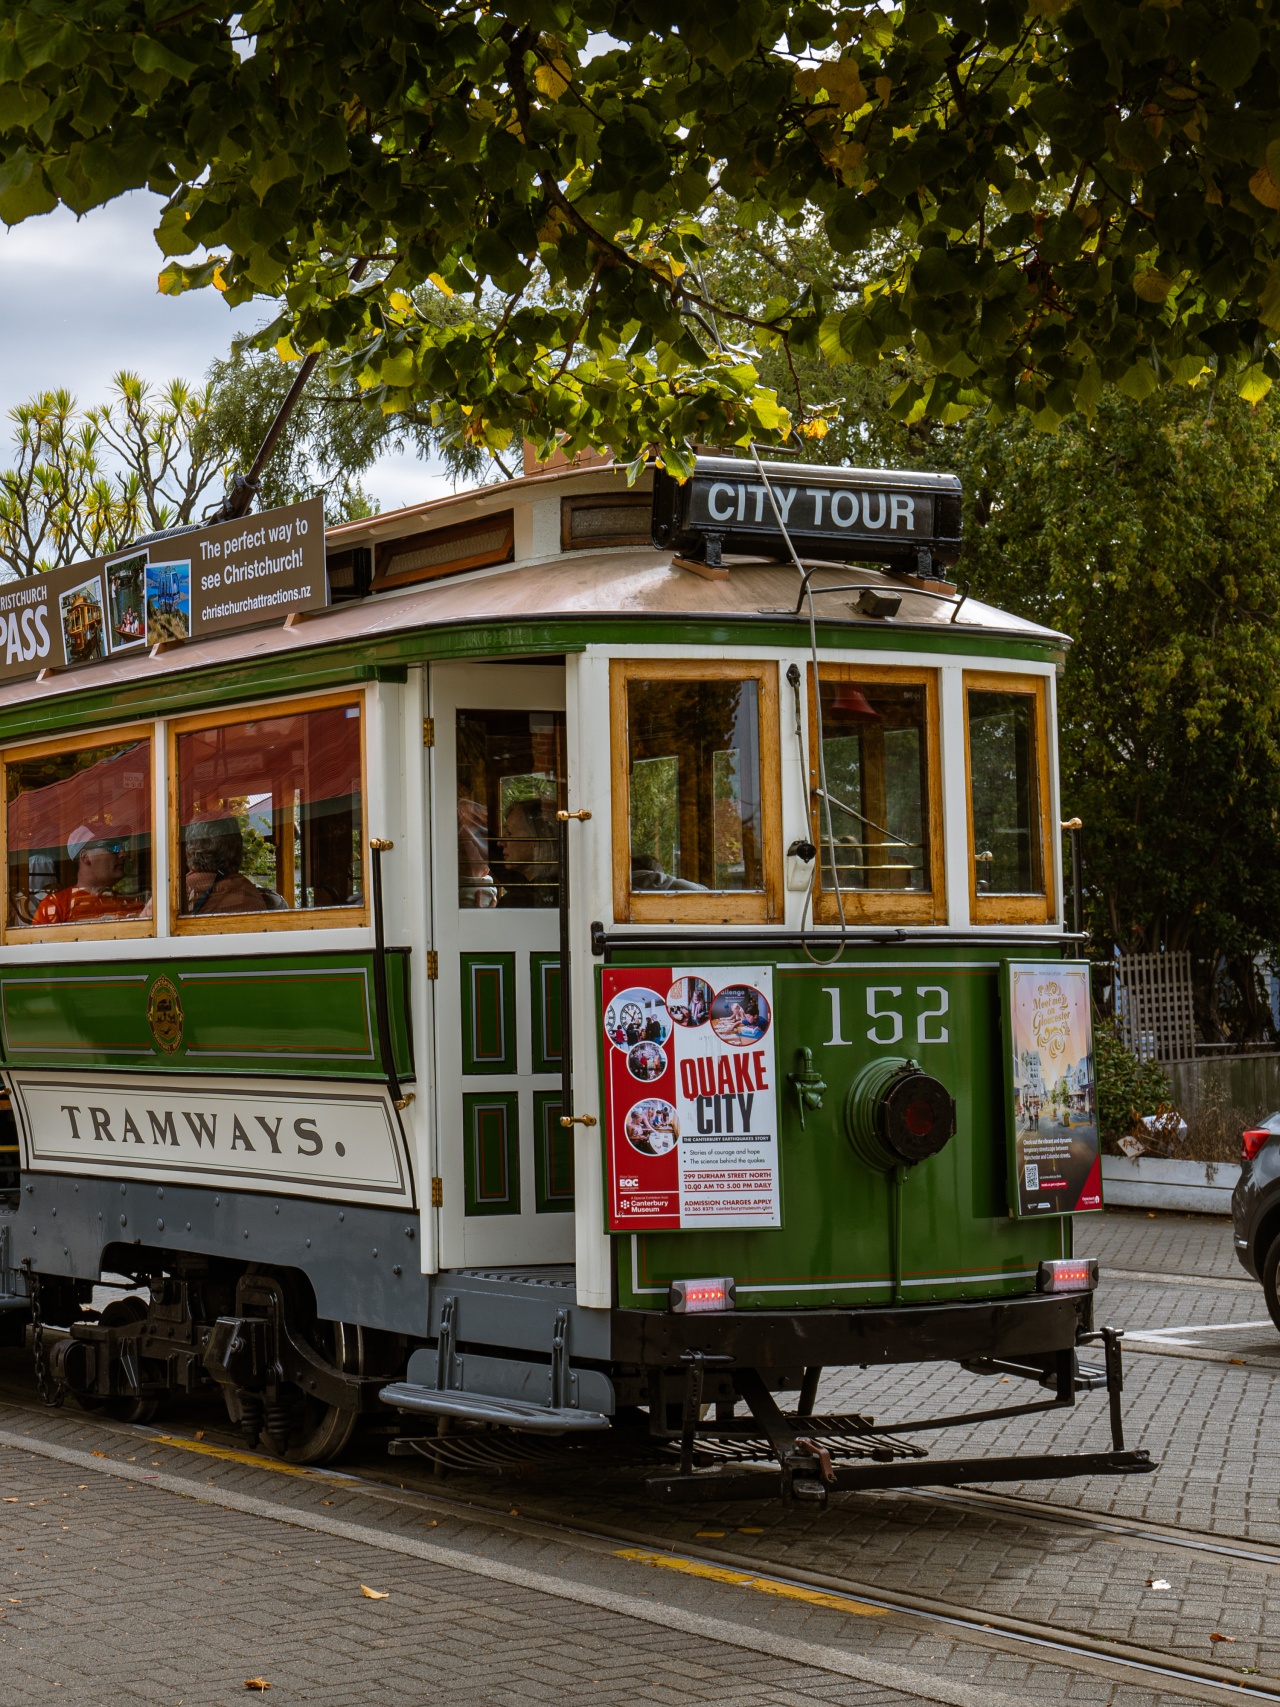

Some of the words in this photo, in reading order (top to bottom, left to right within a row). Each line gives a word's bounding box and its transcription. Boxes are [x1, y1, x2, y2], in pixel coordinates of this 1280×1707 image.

[708, 482, 797, 523] CITY
[806, 488, 915, 531] TOUR
[200, 541, 221, 560] The
[224, 527, 265, 559] perfect
[268, 523, 293, 543] way
[296, 518, 308, 536] to
[201, 573, 221, 590] see
[224, 548, 303, 584] Christchurch!
[202, 585, 311, 620] christchurchattractions.nz
[821, 986, 949, 1046] 152
[1033, 997, 1051, 1011] Meet
[1052, 997, 1061, 1005] me
[1033, 1011, 1070, 1036] Gloucester
[680, 1051, 769, 1101] QUAKE
[61, 1106, 346, 1158] TRAMWAYS.
[696, 1093, 754, 1134] CITY
[619, 1179, 639, 1187] EQC
